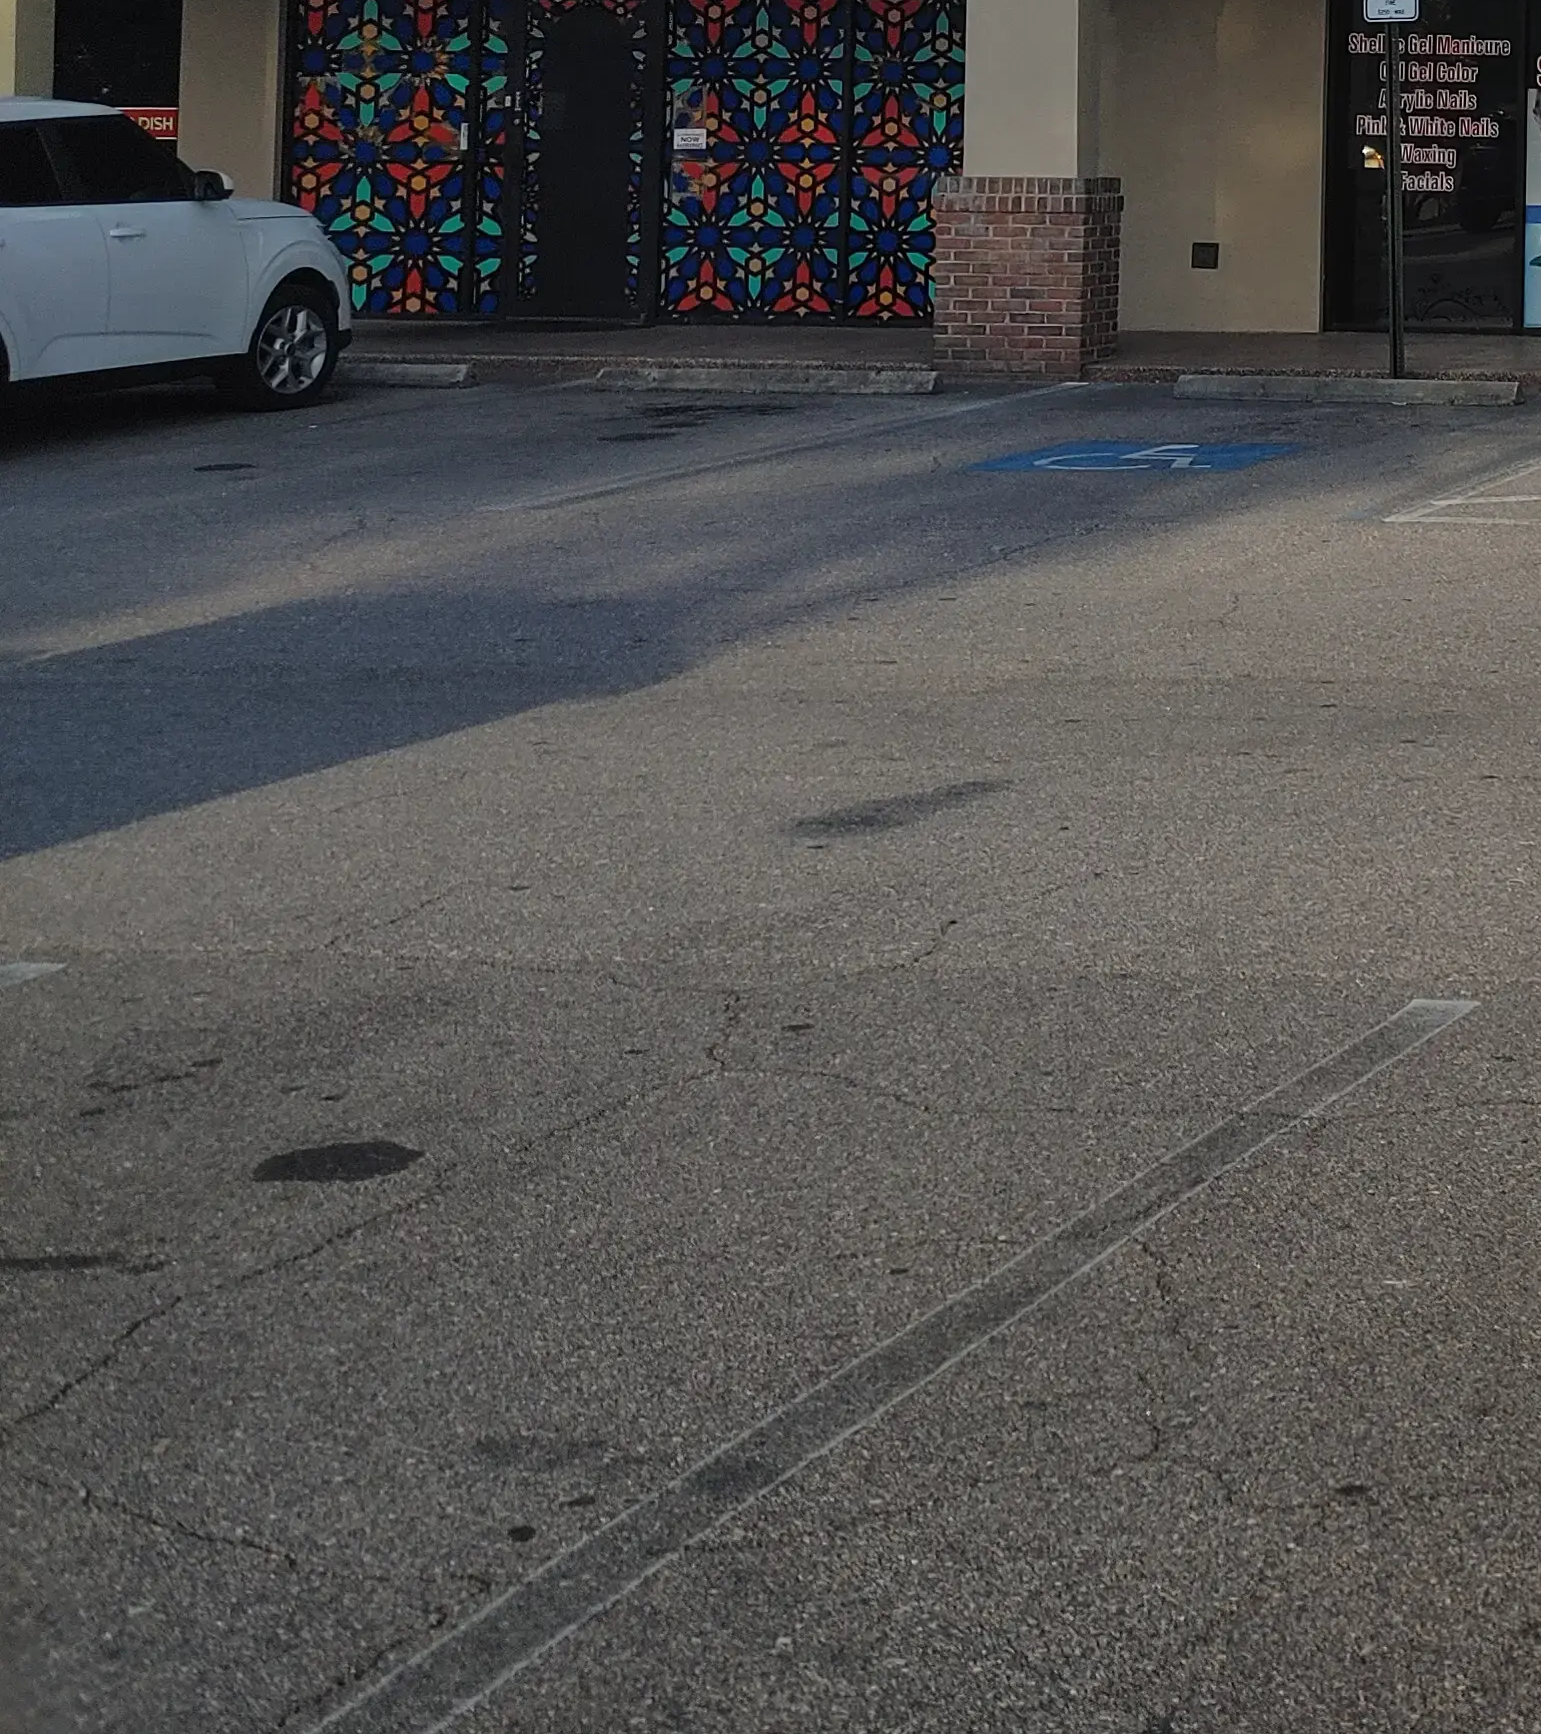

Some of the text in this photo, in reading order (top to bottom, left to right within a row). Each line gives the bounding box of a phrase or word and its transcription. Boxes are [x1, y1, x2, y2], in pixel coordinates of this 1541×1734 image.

[1408, 34, 1433, 54] Gel
[1436, 35, 1511, 55] Manicure
[1408, 61, 1478, 82] Gel Color
[1378, 89, 1477, 113] Arylic Nails
[1409, 116, 1455, 136] White
[1459, 117, 1499, 137] Nails
[1400, 143, 1456, 169] Waxing
